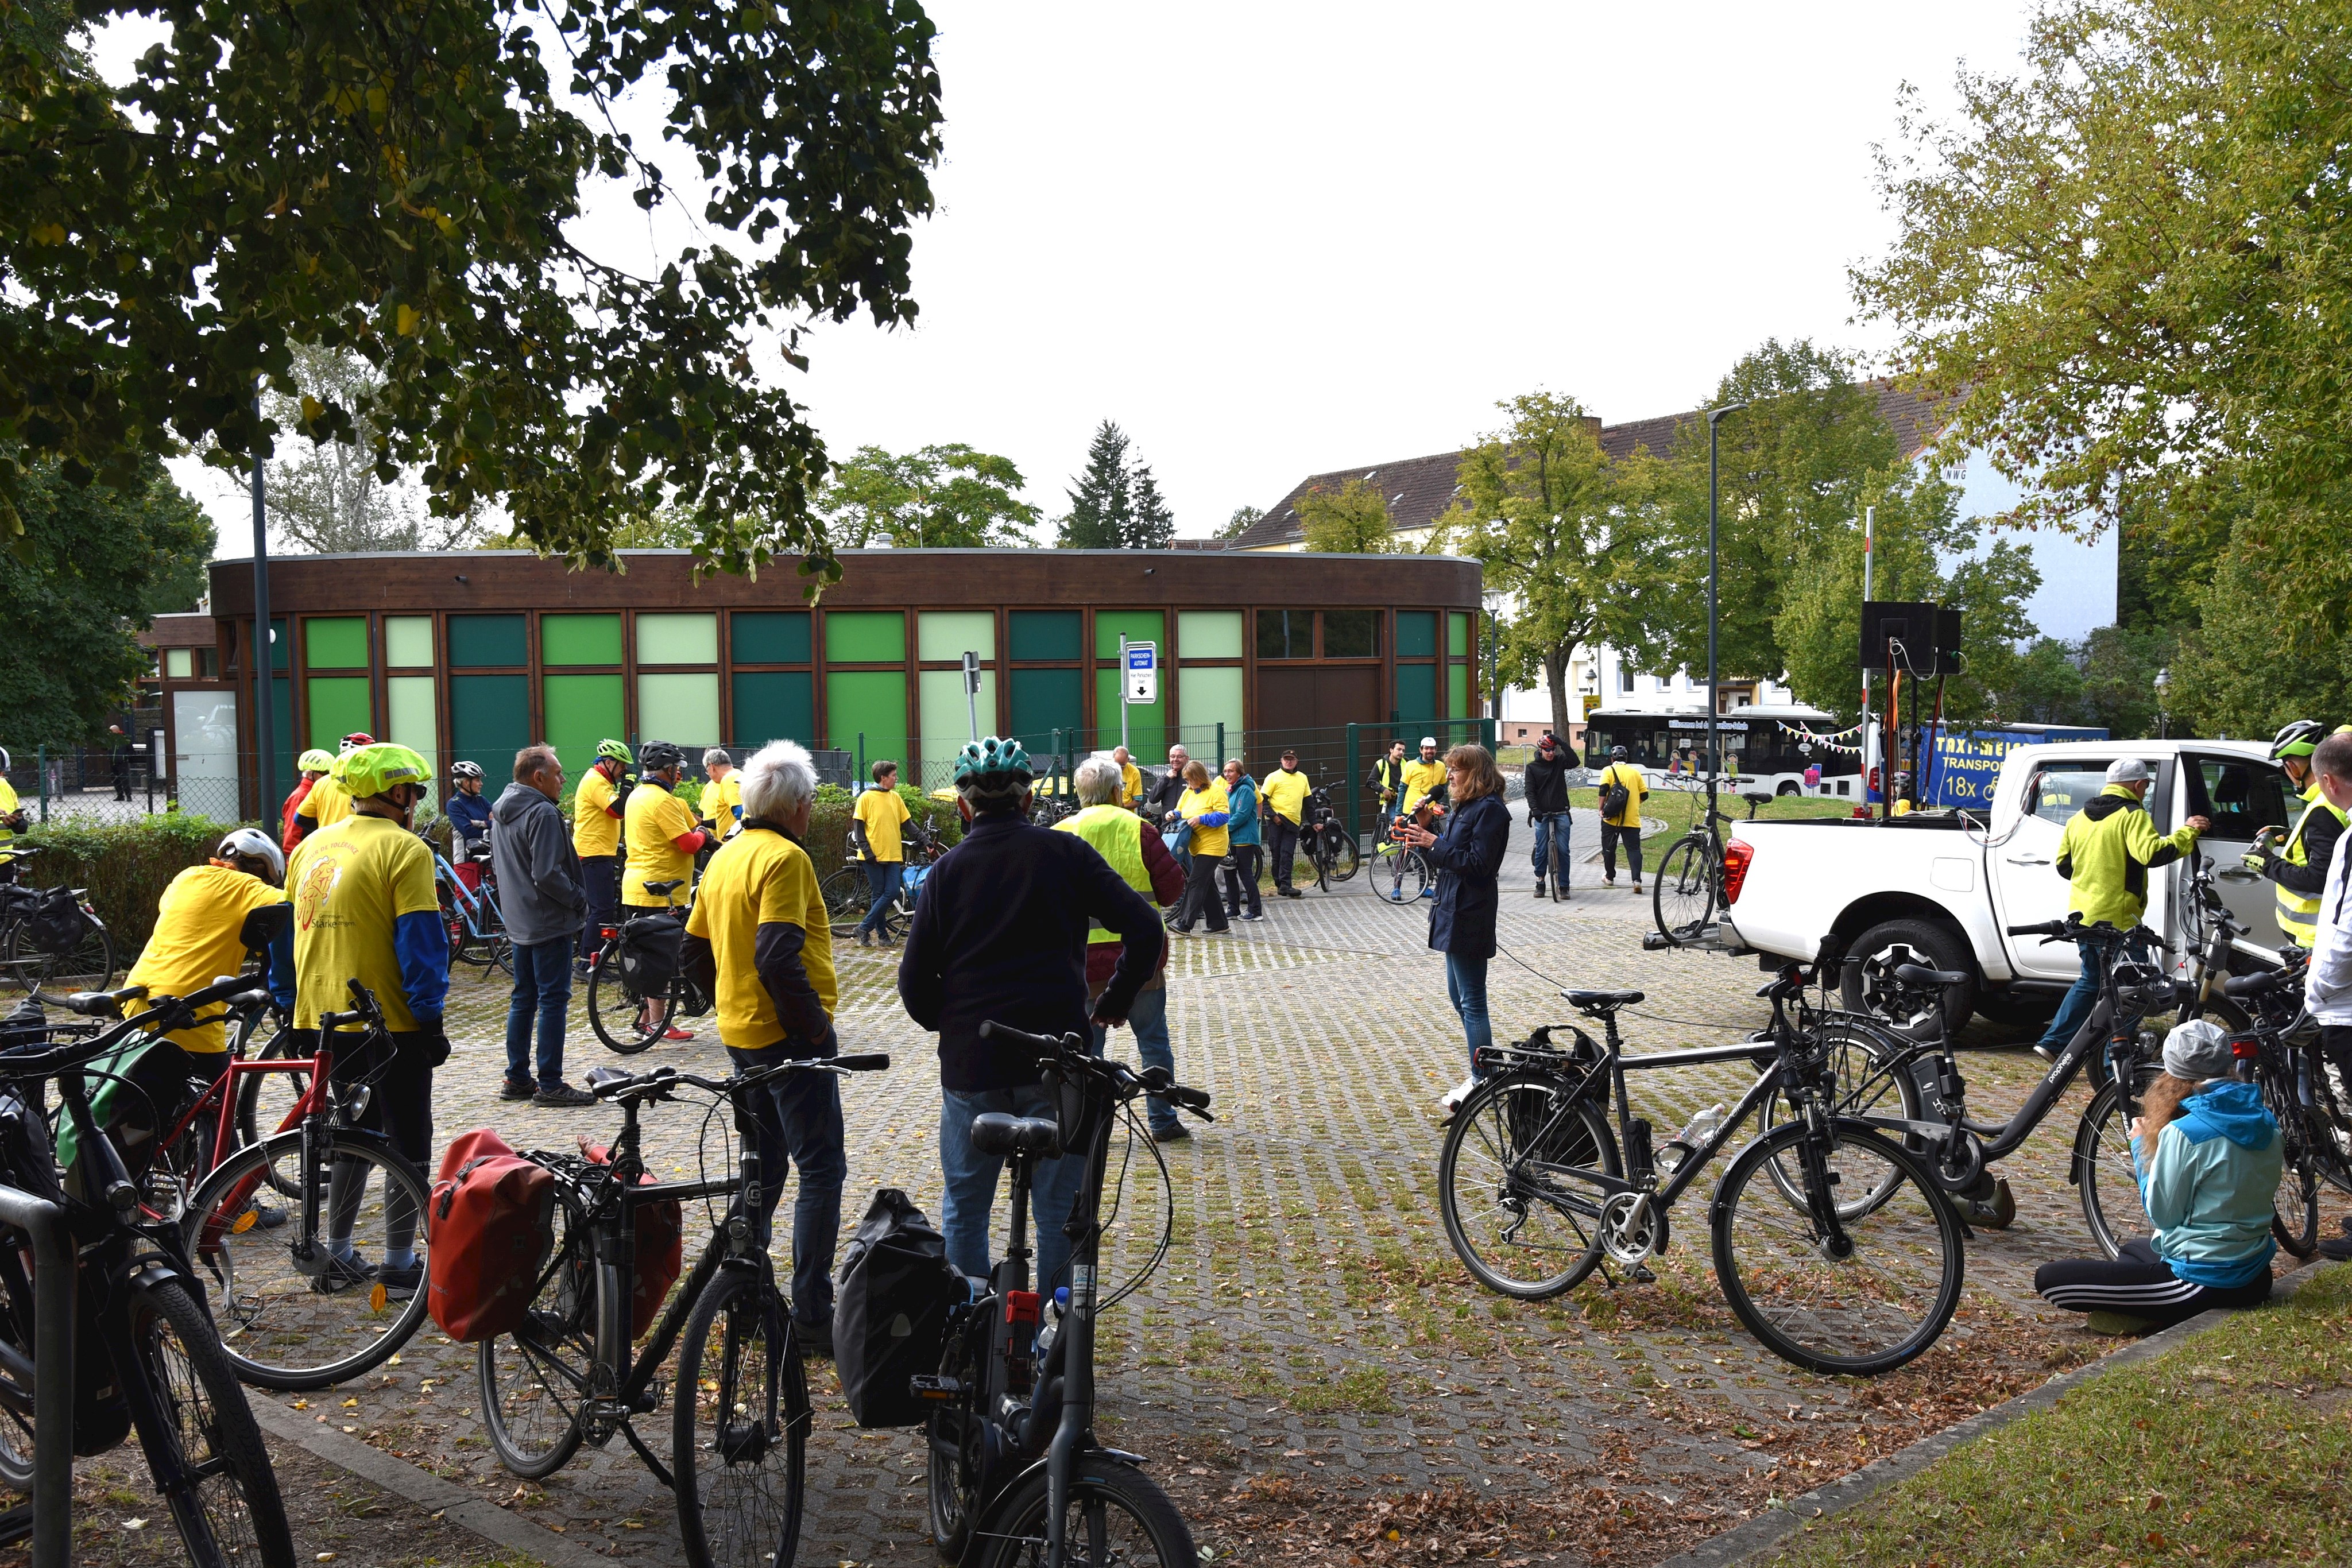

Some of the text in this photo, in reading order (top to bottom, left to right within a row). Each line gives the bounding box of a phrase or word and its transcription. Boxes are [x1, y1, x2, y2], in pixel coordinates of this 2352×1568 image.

[1946, 470, 1967, 480] NWG
[1669, 720, 1695, 729] Willkommen
[1716, 721, 1748, 730] velbus-Schule
[1947, 776, 1976, 797] 18x
[320, 845, 329, 853] DE
[311, 919, 337, 929] Stärke
[2048, 1052, 2072, 1084] prophete
